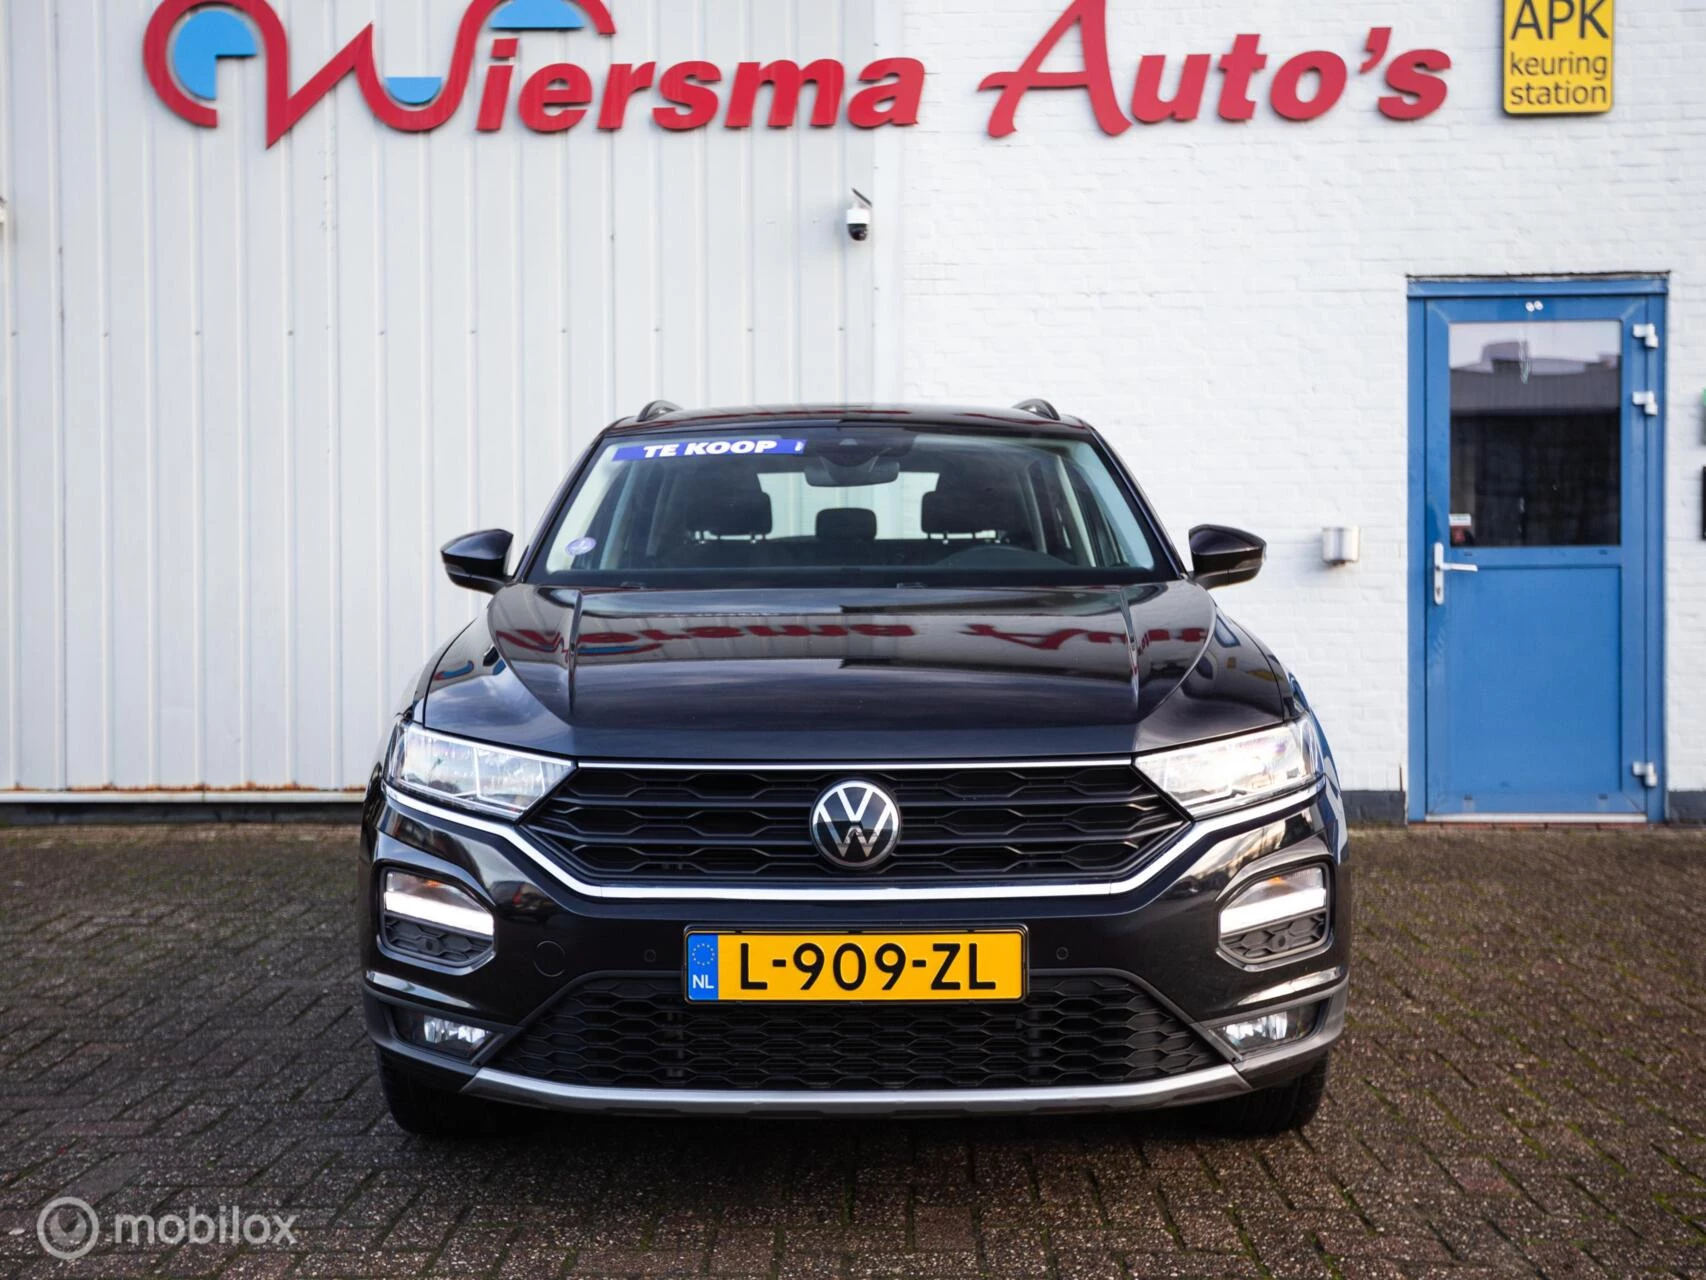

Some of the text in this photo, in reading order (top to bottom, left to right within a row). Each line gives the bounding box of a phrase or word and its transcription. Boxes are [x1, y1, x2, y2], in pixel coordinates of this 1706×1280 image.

[1510, 0, 1609, 40] APK
[143, 0, 1451, 149] Wiersma Auto's
[1510, 51, 1607, 81] keuring
[1510, 80, 1607, 105] station
[643, 440, 777, 458] TE KOOP
[692, 974, 714, 989] NL
[740, 942, 996, 991] L-909-ZL
